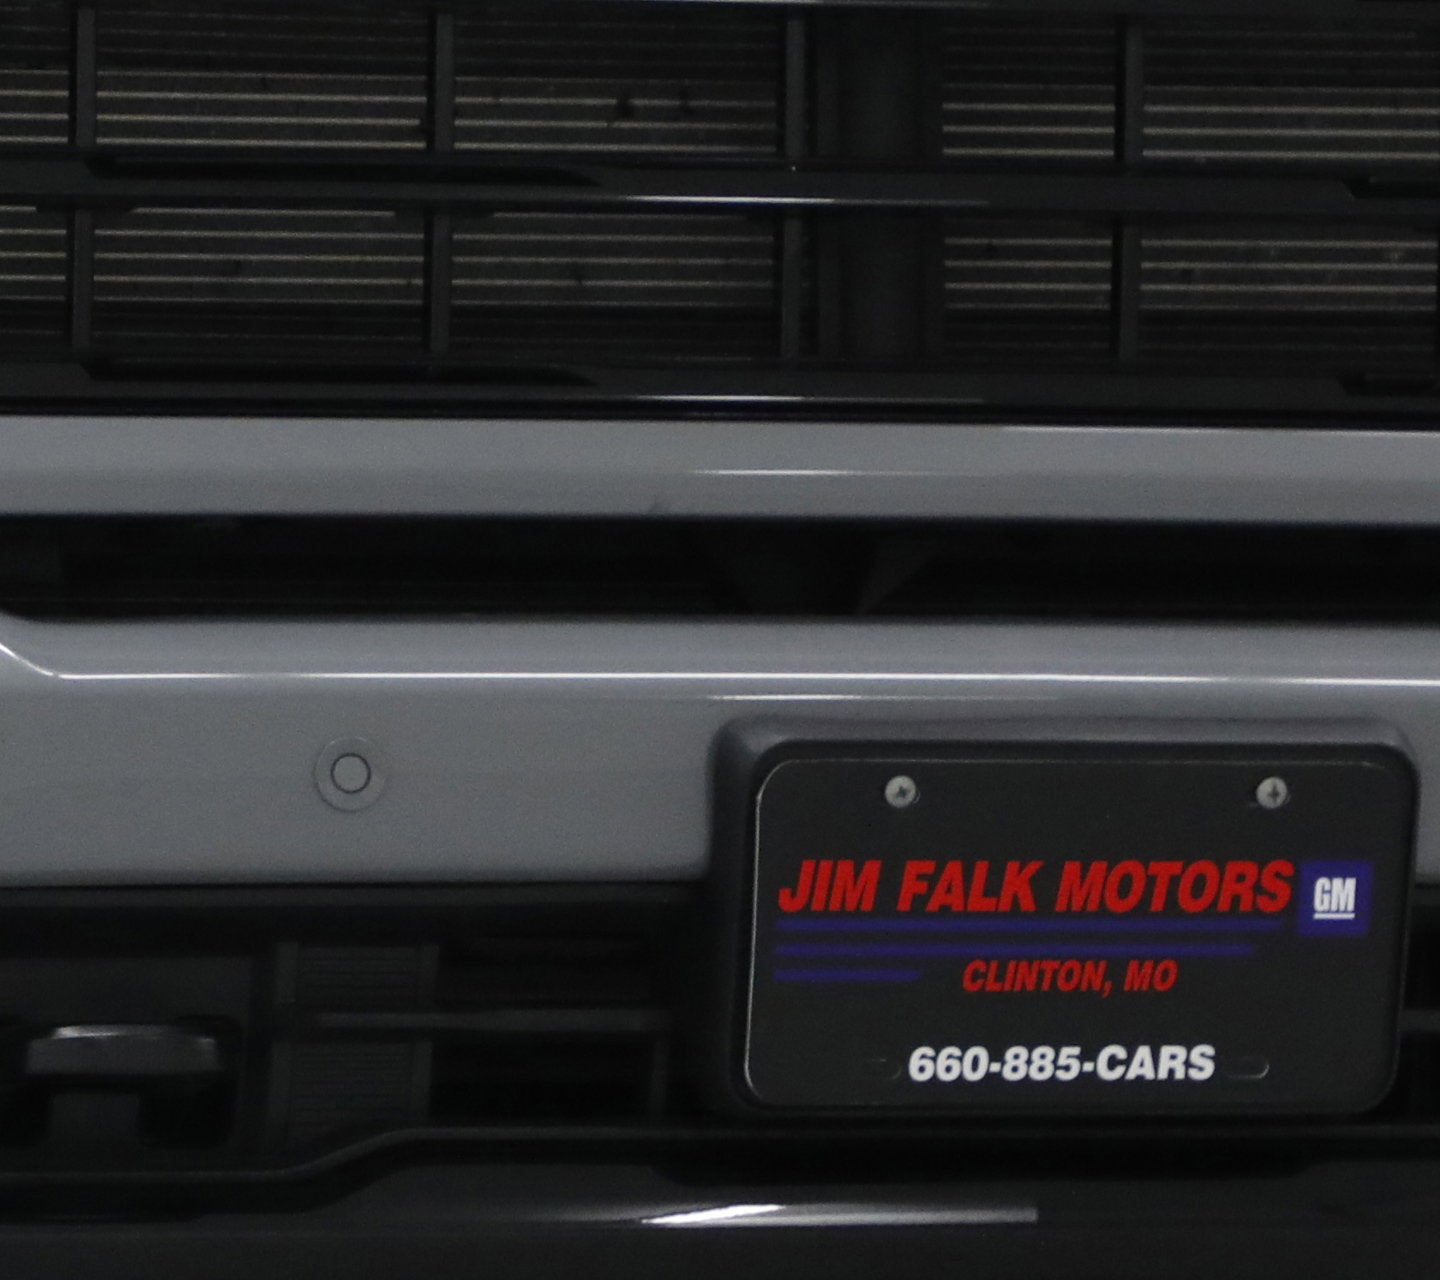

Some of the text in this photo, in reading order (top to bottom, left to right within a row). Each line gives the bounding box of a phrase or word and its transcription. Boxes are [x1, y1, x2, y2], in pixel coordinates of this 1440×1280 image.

[777, 858, 1296, 914] JIM FALK MOTORS
[1313, 875, 1357, 920] GM
[962, 959, 1179, 997] CLINTON, MO
[908, 1043, 1216, 1082] 660-885-CARS
